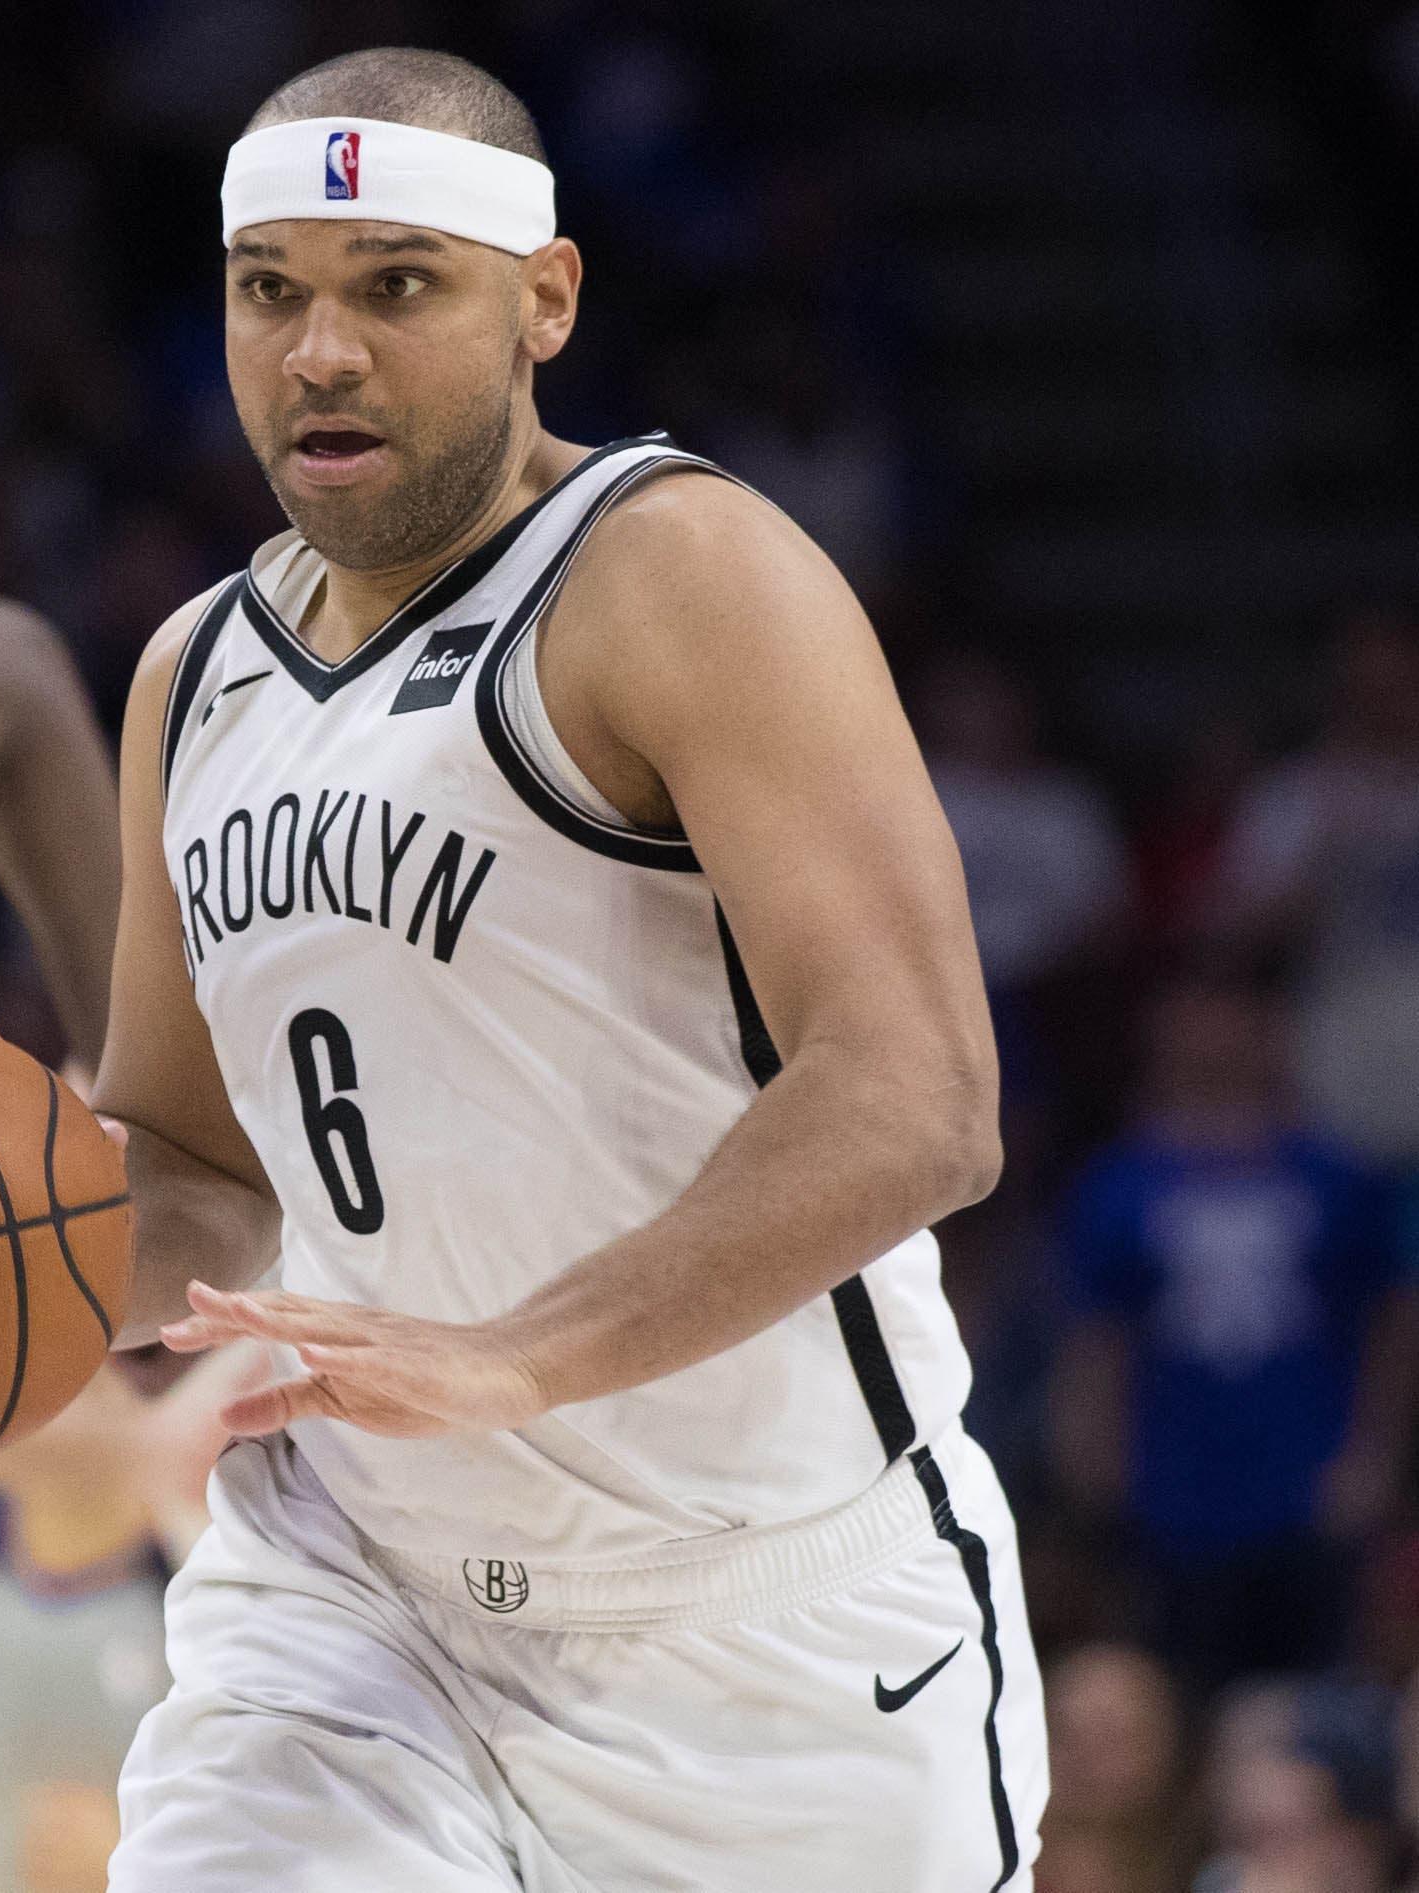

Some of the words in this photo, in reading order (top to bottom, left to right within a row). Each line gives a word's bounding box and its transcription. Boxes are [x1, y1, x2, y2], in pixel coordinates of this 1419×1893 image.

[409, 649, 473, 681] infor
[176, 789, 496, 966] ROOKLYN
[288, 1008, 384, 1235] 6
